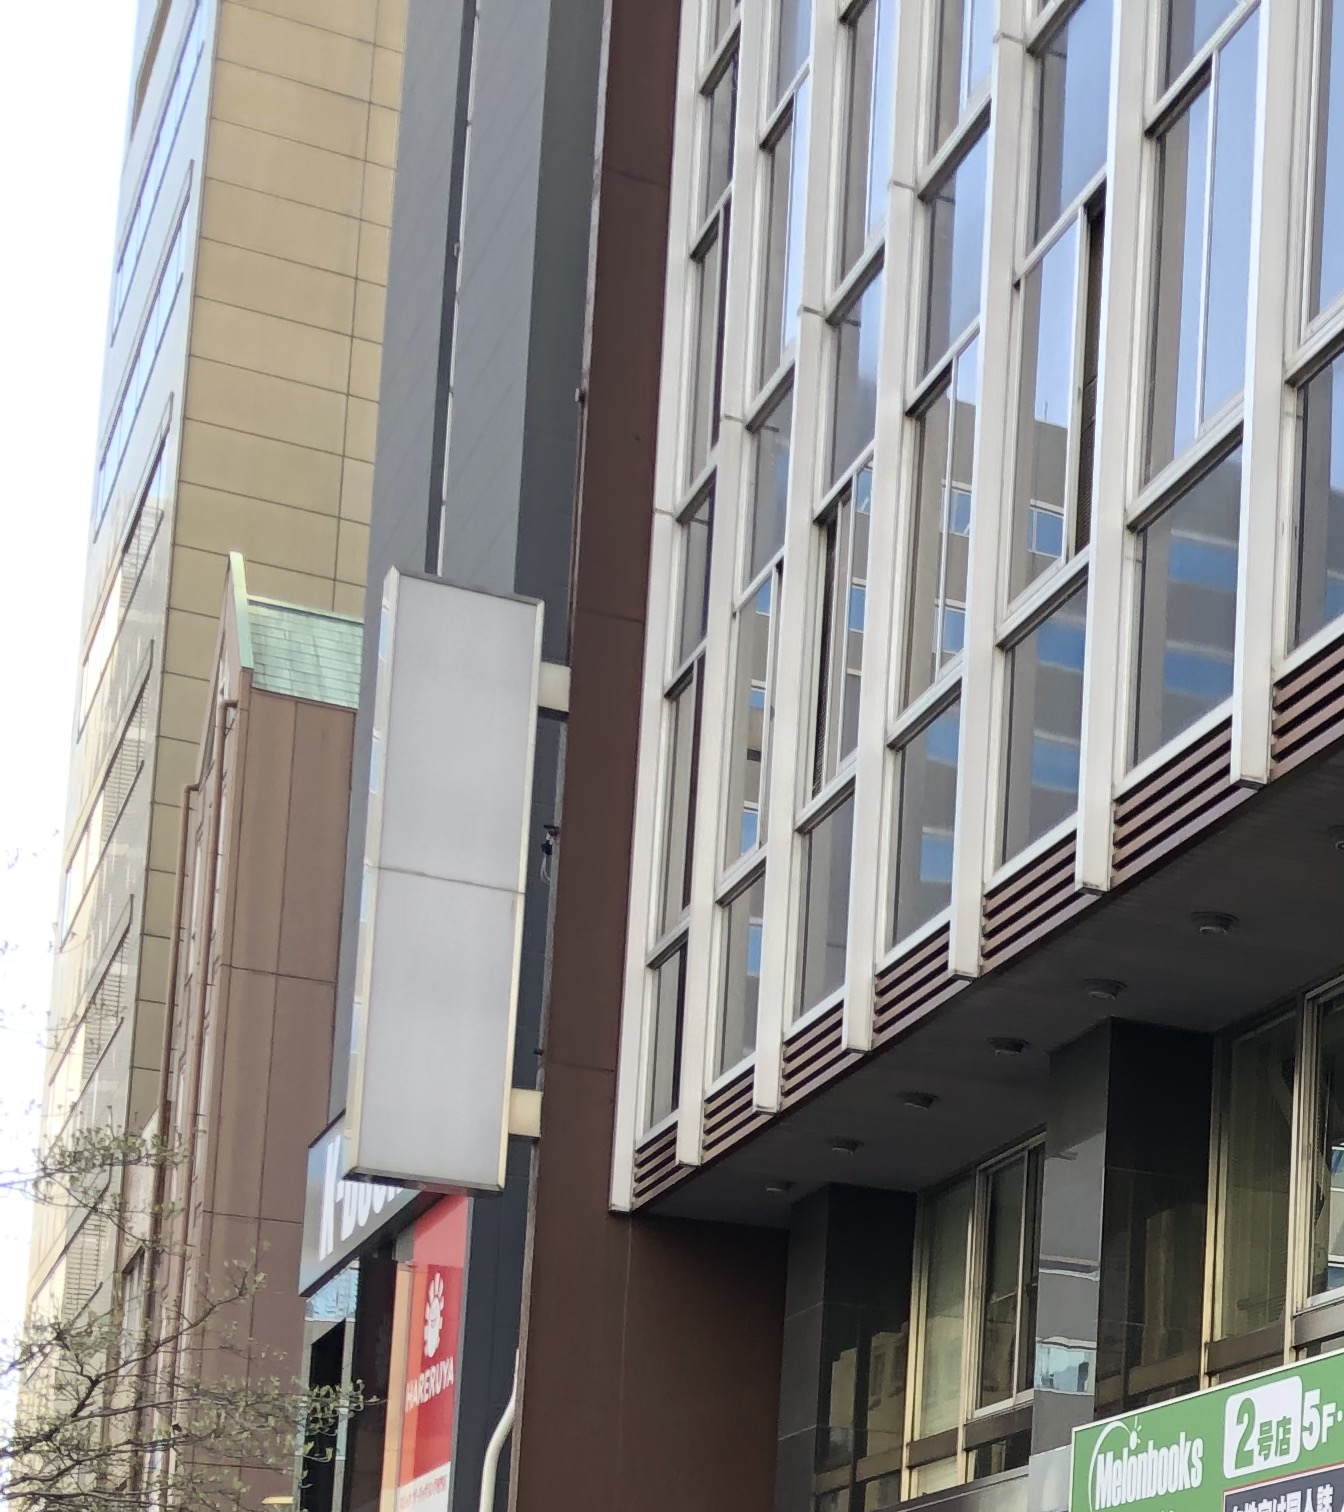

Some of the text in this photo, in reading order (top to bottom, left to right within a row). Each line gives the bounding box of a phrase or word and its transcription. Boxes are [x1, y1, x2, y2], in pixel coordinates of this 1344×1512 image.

[405, 1357, 455, 1414] HARERUYA
[1094, 1431, 1205, 1511] Melonbooks
[1233, 1396, 1293, 1473] 2号店
